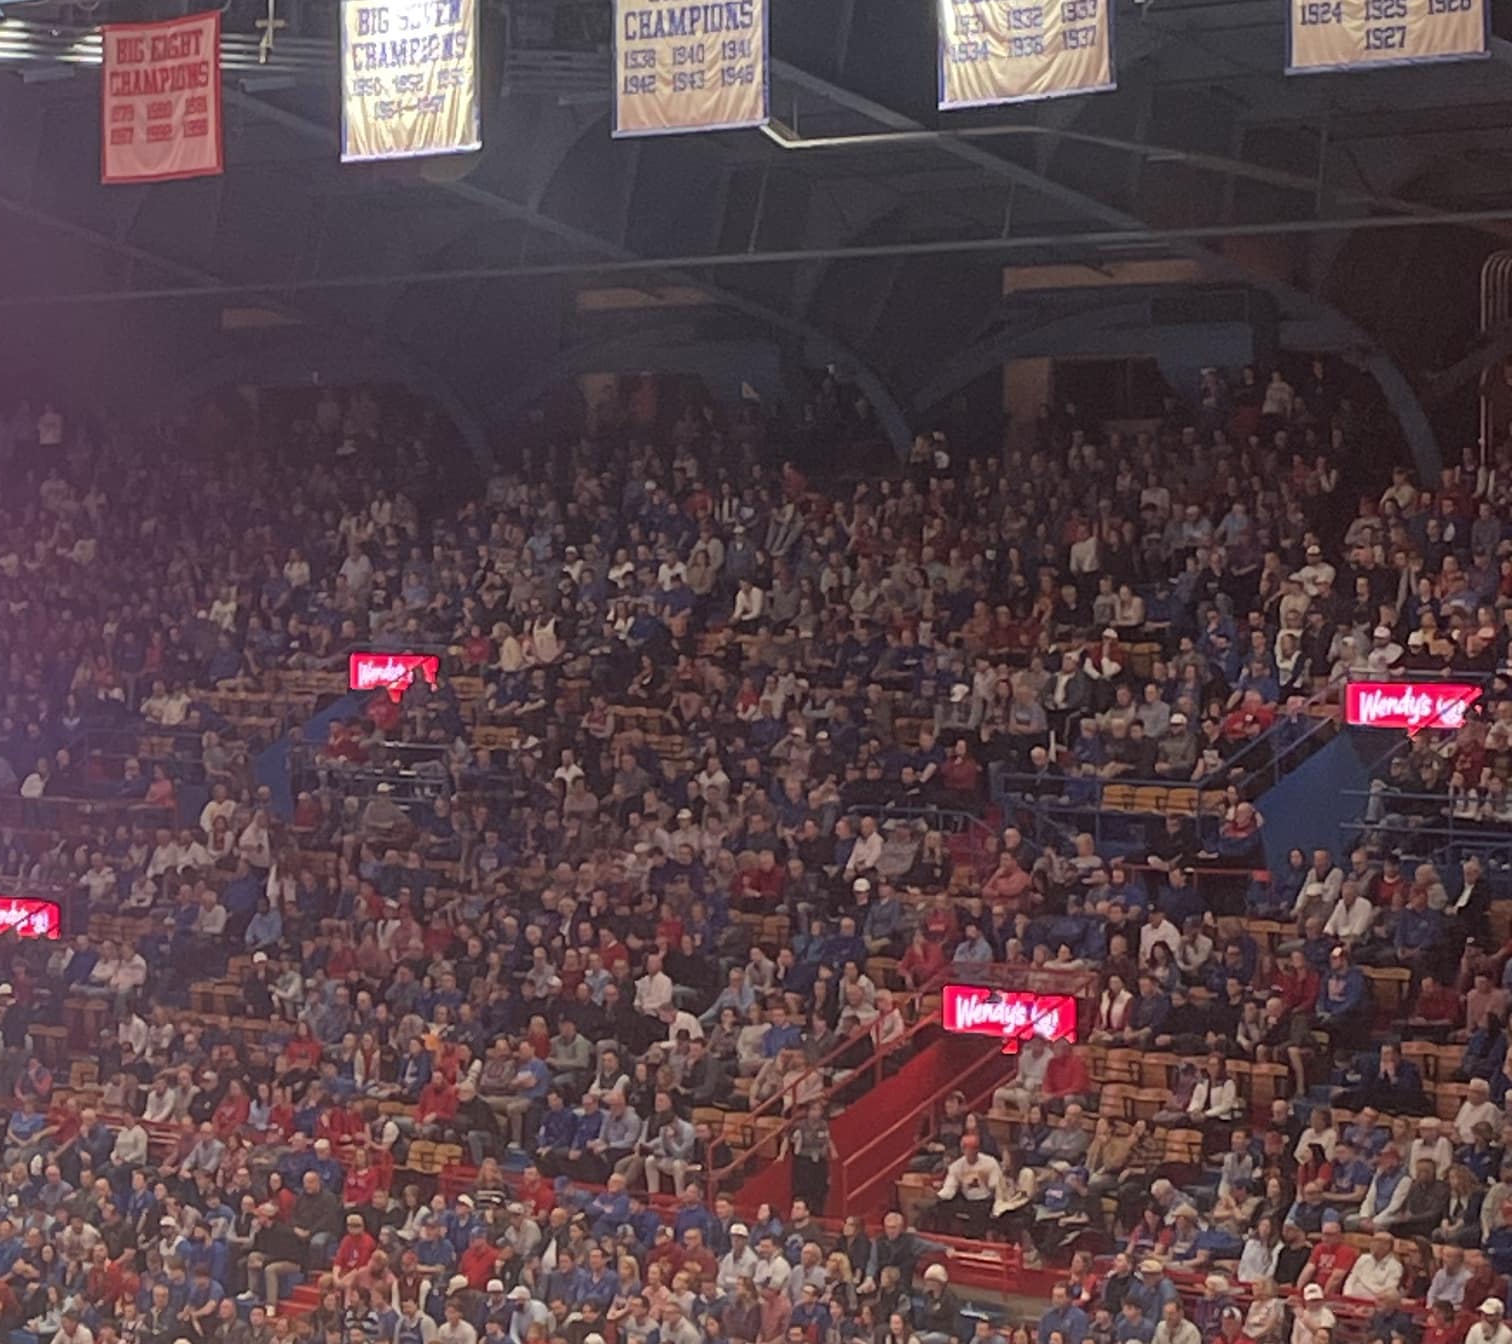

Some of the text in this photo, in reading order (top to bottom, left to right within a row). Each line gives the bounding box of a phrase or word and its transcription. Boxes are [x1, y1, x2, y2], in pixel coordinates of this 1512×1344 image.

[357, 7, 389, 36] BIG
[624, 0, 753, 41] CHAMPIONS
[1007, 6, 1043, 30] 1932
[1300, 1, 1342, 25] 1924
[116, 28, 203, 64] BIG EIGHT
[351, 30, 467, 71] CHAMPIONS
[1062, 25, 1097, 50] 1937
[1364, 25, 1407, 50] 1927
[672, 40, 752, 66] 1940 1941
[110, 61, 209, 96] CHAMPIONS
[623, 74, 656, 95] 1942
[672, 70, 705, 93] 1943
[1359, 685, 1432, 725] Wendy's
[956, 993, 1026, 1033] Wendy's
